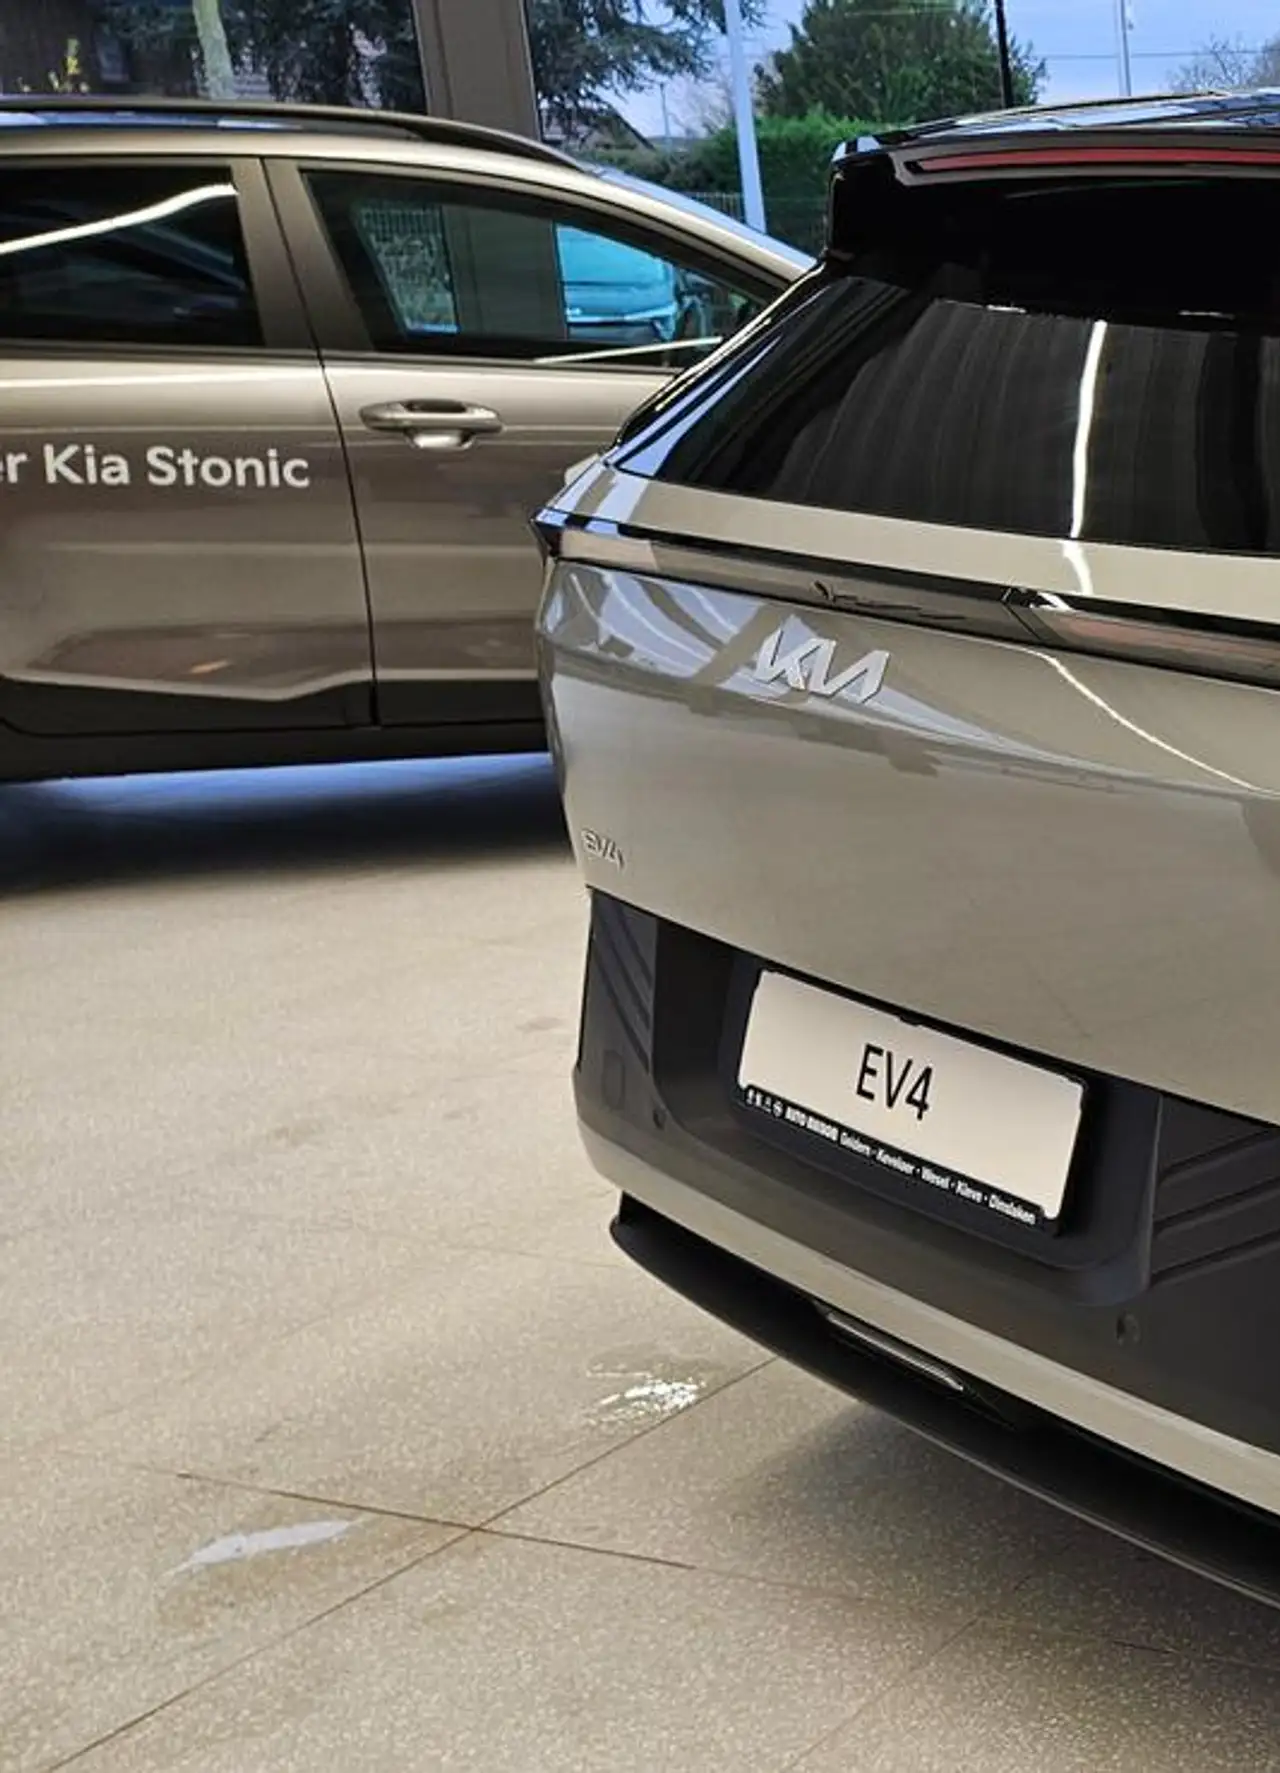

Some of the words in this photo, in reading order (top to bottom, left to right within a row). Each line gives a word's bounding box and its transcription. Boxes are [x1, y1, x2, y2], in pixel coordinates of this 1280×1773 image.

[0, 451, 27, 484] r
[43, 443, 130, 485] Kia
[146, 445, 310, 488] Stonic
[752, 628, 891, 705] KIA
[856, 1043, 934, 1122] EV4
